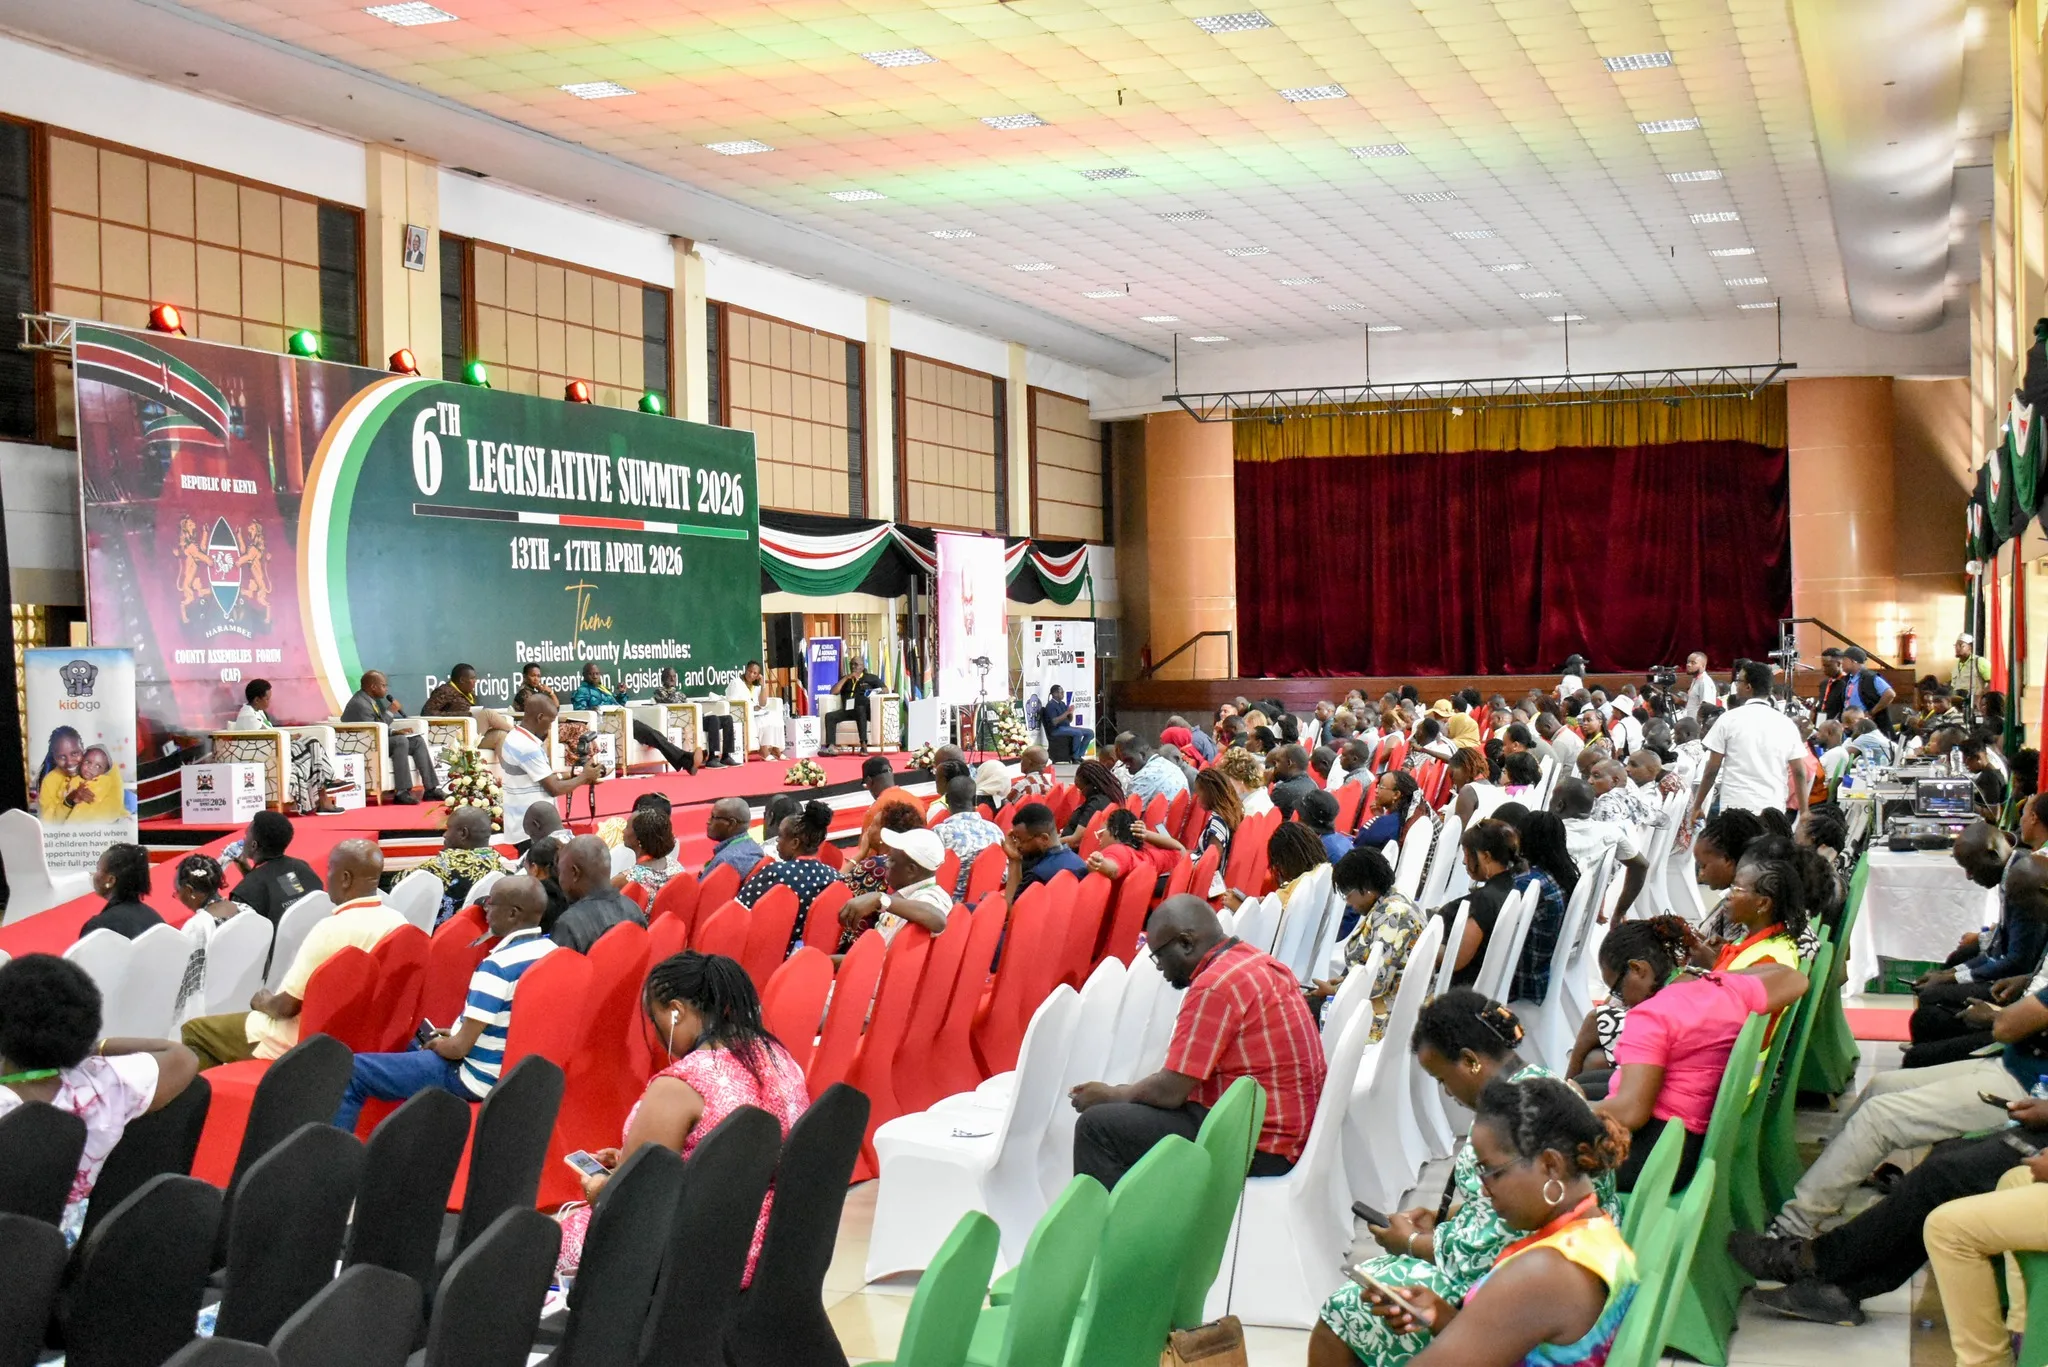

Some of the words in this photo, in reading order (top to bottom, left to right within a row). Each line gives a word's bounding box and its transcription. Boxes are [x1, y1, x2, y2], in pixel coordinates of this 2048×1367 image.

[181, 474, 219, 492] REPUBLIC
[221, 478, 231, 493] OF
[232, 479, 258, 495] KENYA
[467, 439, 613, 505] LEGISLATIVE
[618, 456, 691, 511] SUMMIT
[697, 468, 745, 517] 2026
[509, 536, 551, 571] 13TH
[564, 539, 602, 573] 17TH
[605, 542, 647, 574] APRIL
[649, 544, 684, 576] 2026
[564, 578, 614, 649] Theme
[205, 624, 252, 639] HARAMBEE
[175, 649, 206, 664] COUNTY
[207, 648, 253, 664] ASSEMBLIES
[255, 648, 282, 663] FORUM
[516, 640, 574, 663] Resilient
[577, 639, 619, 666] County
[623, 638, 692, 660] Assemblies:
[220, 667, 242, 684] (CAF)
[684, 667, 704, 687] and
[59, 699, 101, 713] kidogo
[210, 797, 227, 807] 2026
[79, 830, 102, 838] world
[103, 829, 128, 837] where
[55, 840, 88, 848] children
[89, 839, 109, 847] have
[47, 860, 66, 868] their
[67, 859, 81, 867] full
